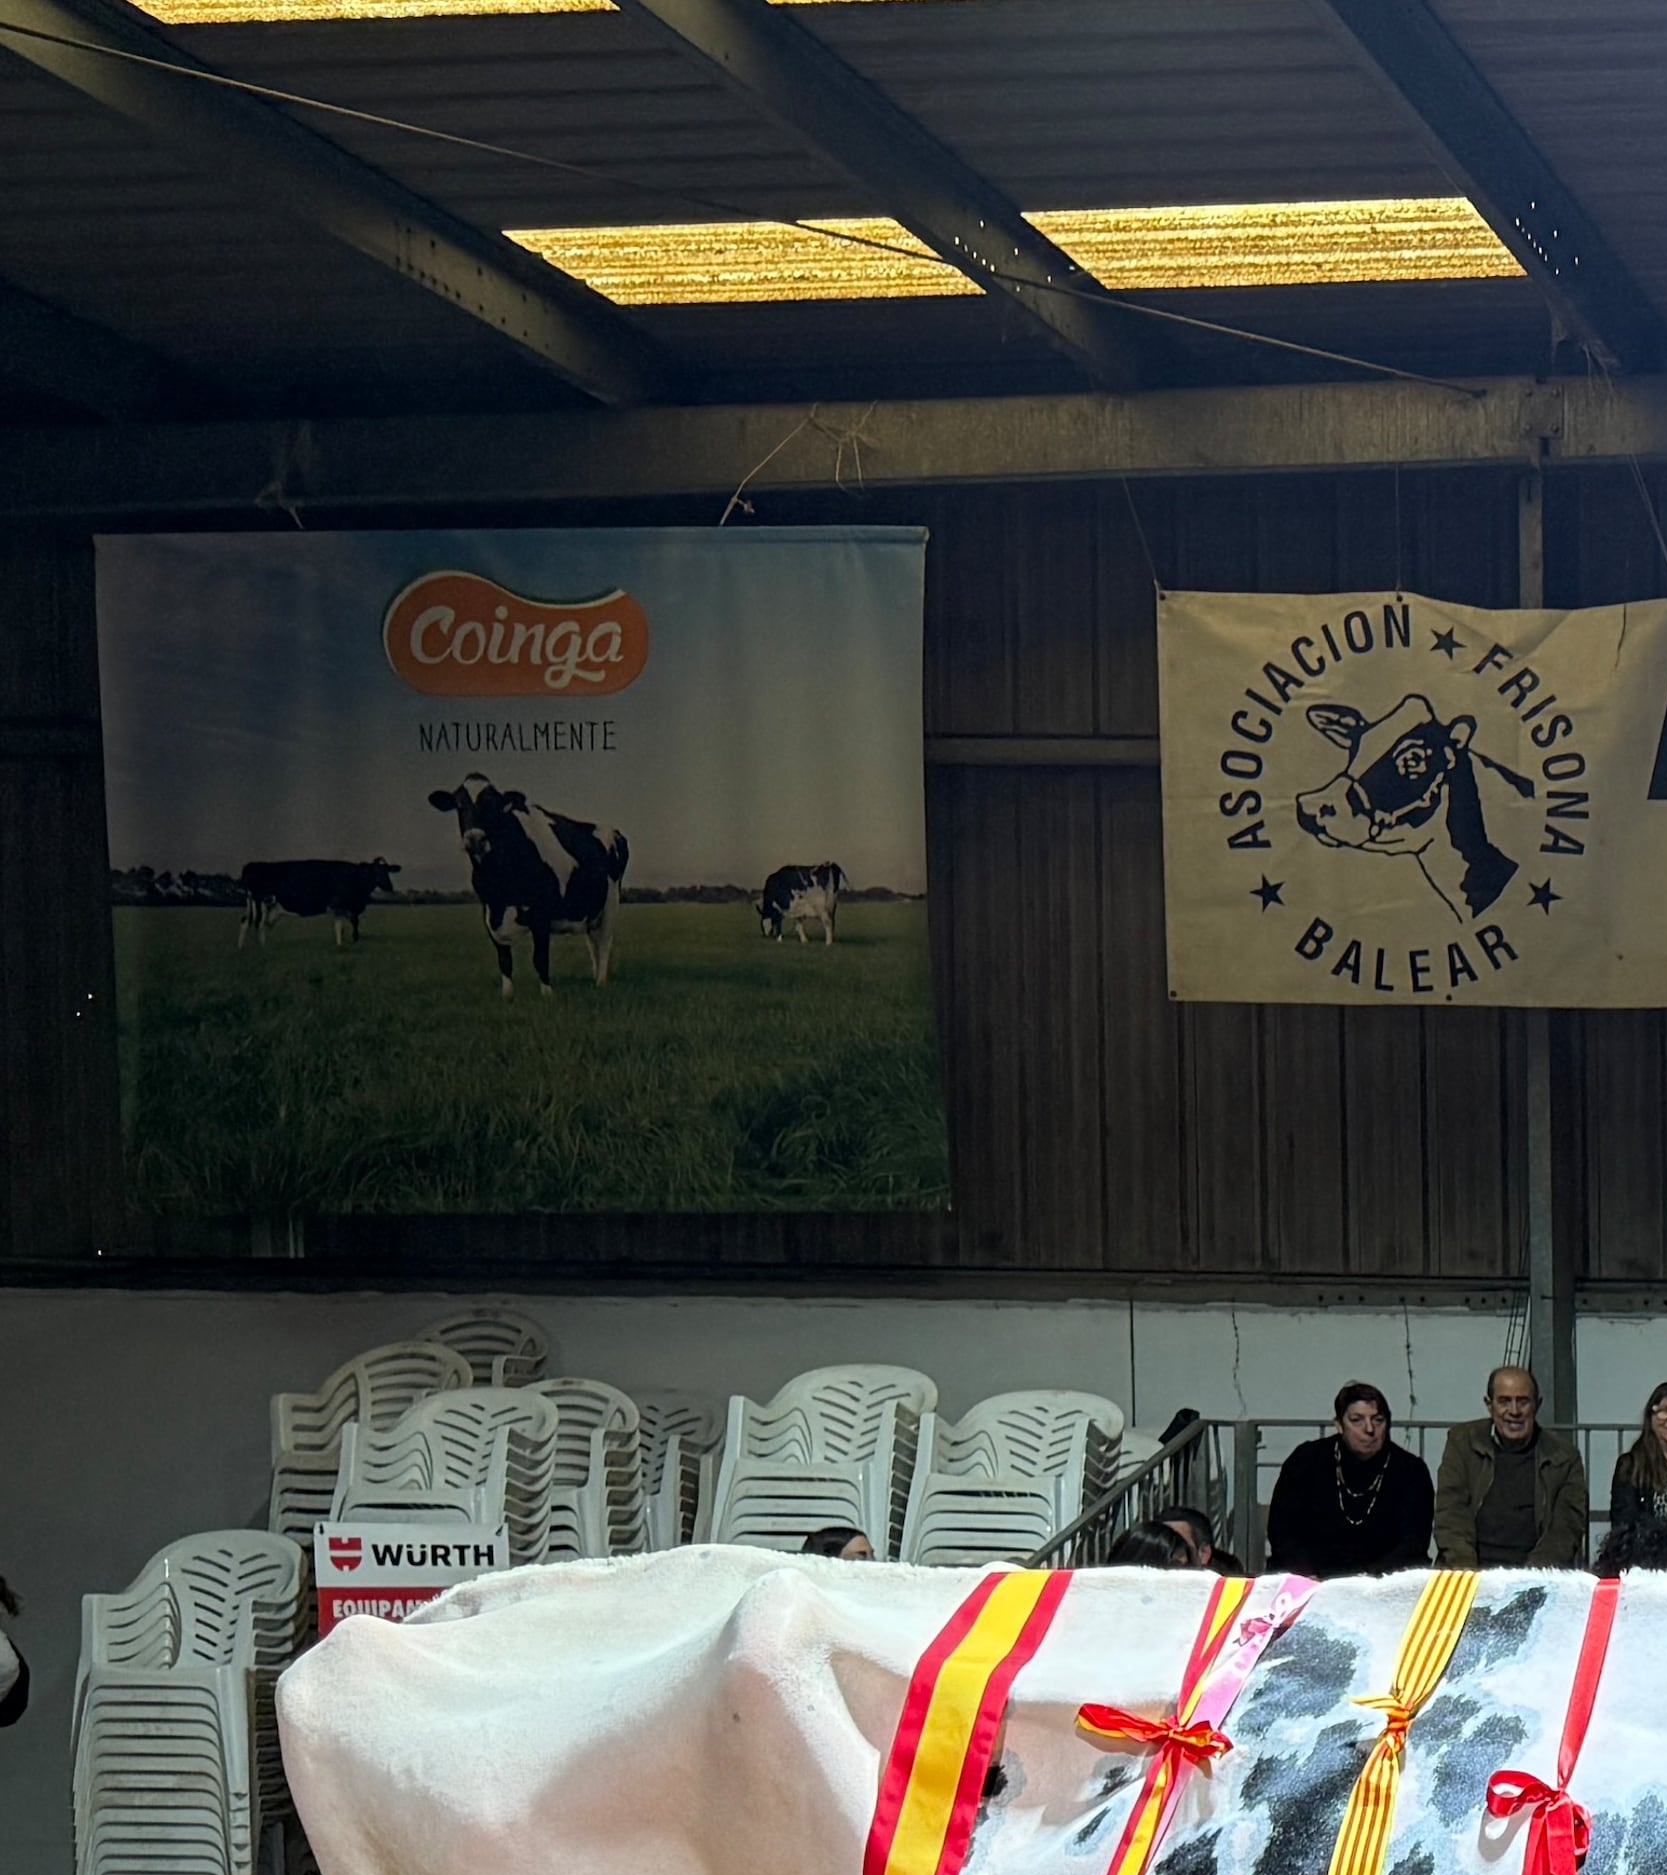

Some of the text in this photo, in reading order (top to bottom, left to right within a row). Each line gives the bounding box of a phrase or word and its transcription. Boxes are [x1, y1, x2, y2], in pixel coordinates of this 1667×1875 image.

[410, 605, 624, 689] Coinga
[419, 720, 617, 752] NATURALMENTE
[1219, 604, 1590, 856] ASOCIACION FRISONA
[1294, 916, 1520, 993] BALEAR
